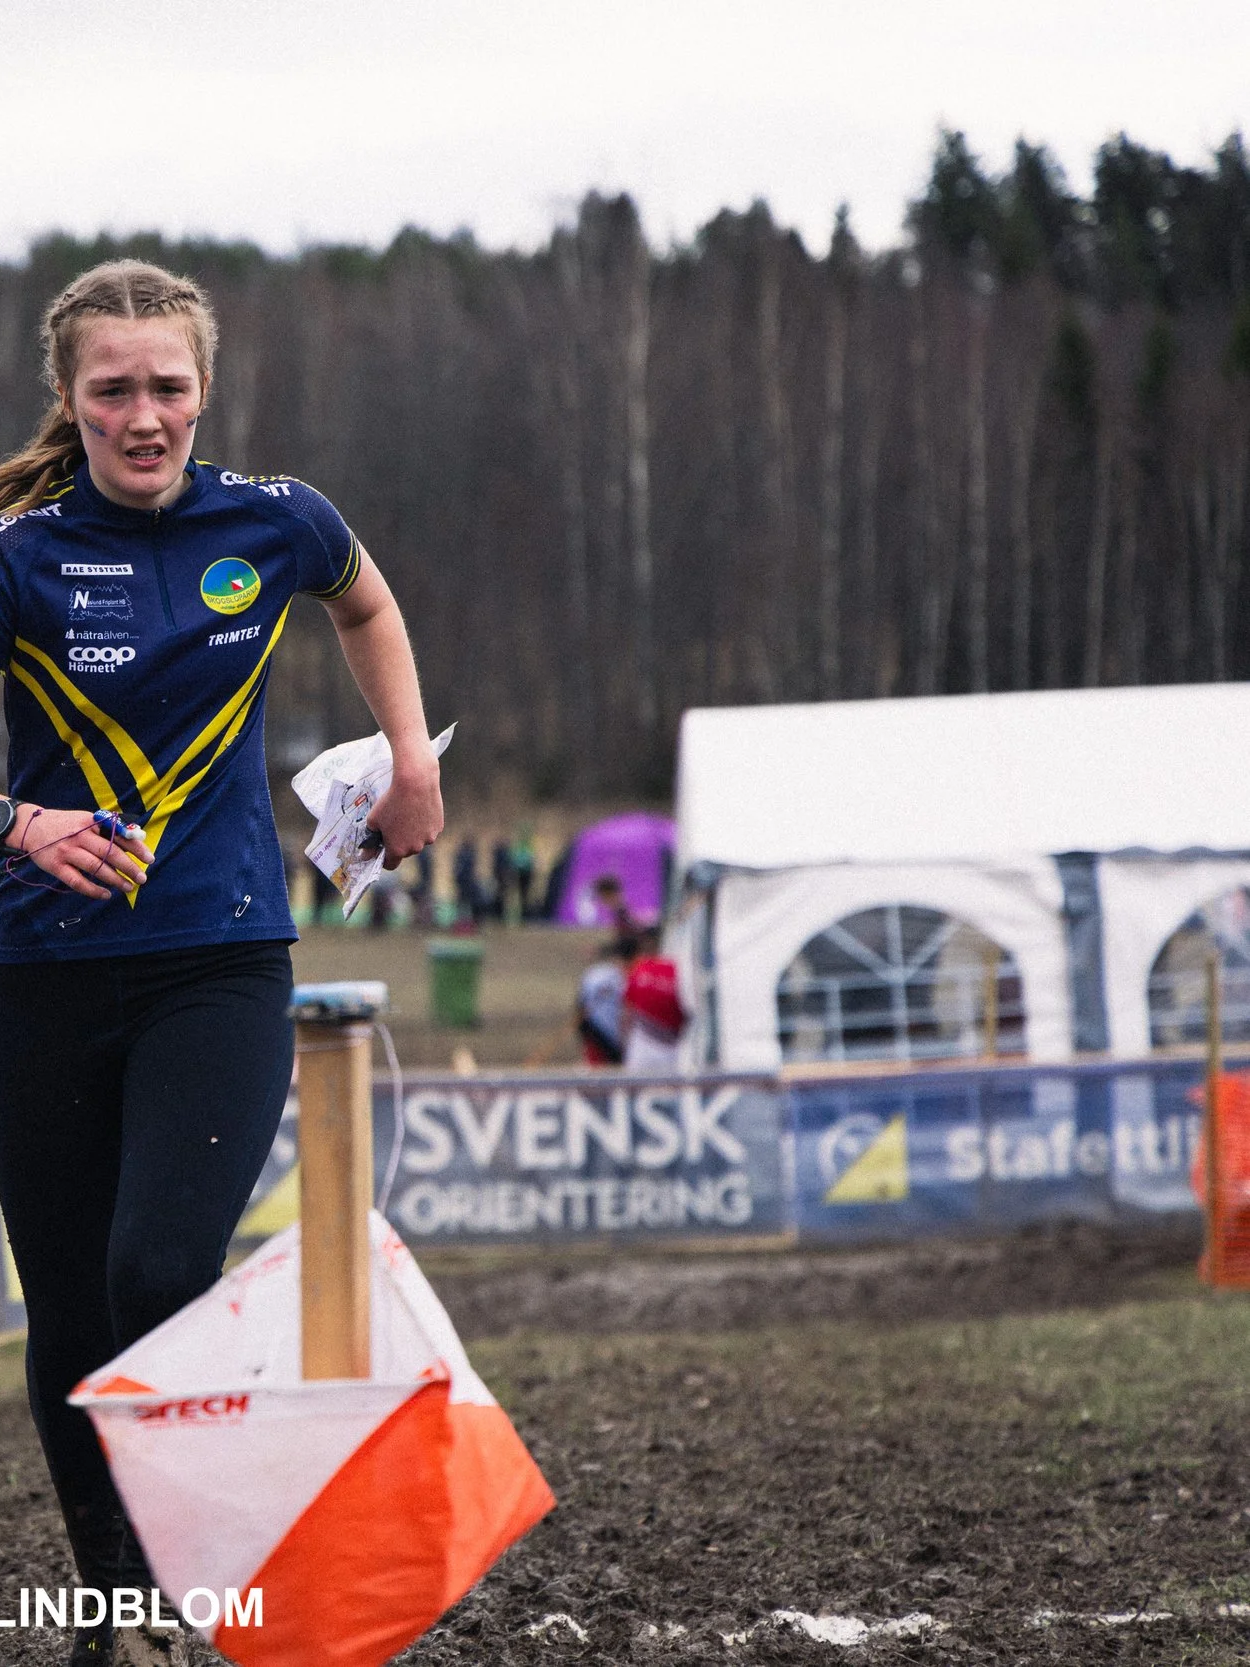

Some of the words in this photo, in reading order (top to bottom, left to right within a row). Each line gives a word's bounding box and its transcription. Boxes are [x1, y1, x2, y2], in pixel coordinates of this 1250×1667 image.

[66, 566, 85, 574] BAE
[87, 566, 129, 574] SYSTEMS
[76, 630, 130, 640] nätraälven
[208, 624, 261, 647] TRIMTEX
[68, 662, 116, 673] Hörnett
[400, 1086, 748, 1174] SVENSK
[398, 1171, 754, 1236] ORIENTERING
